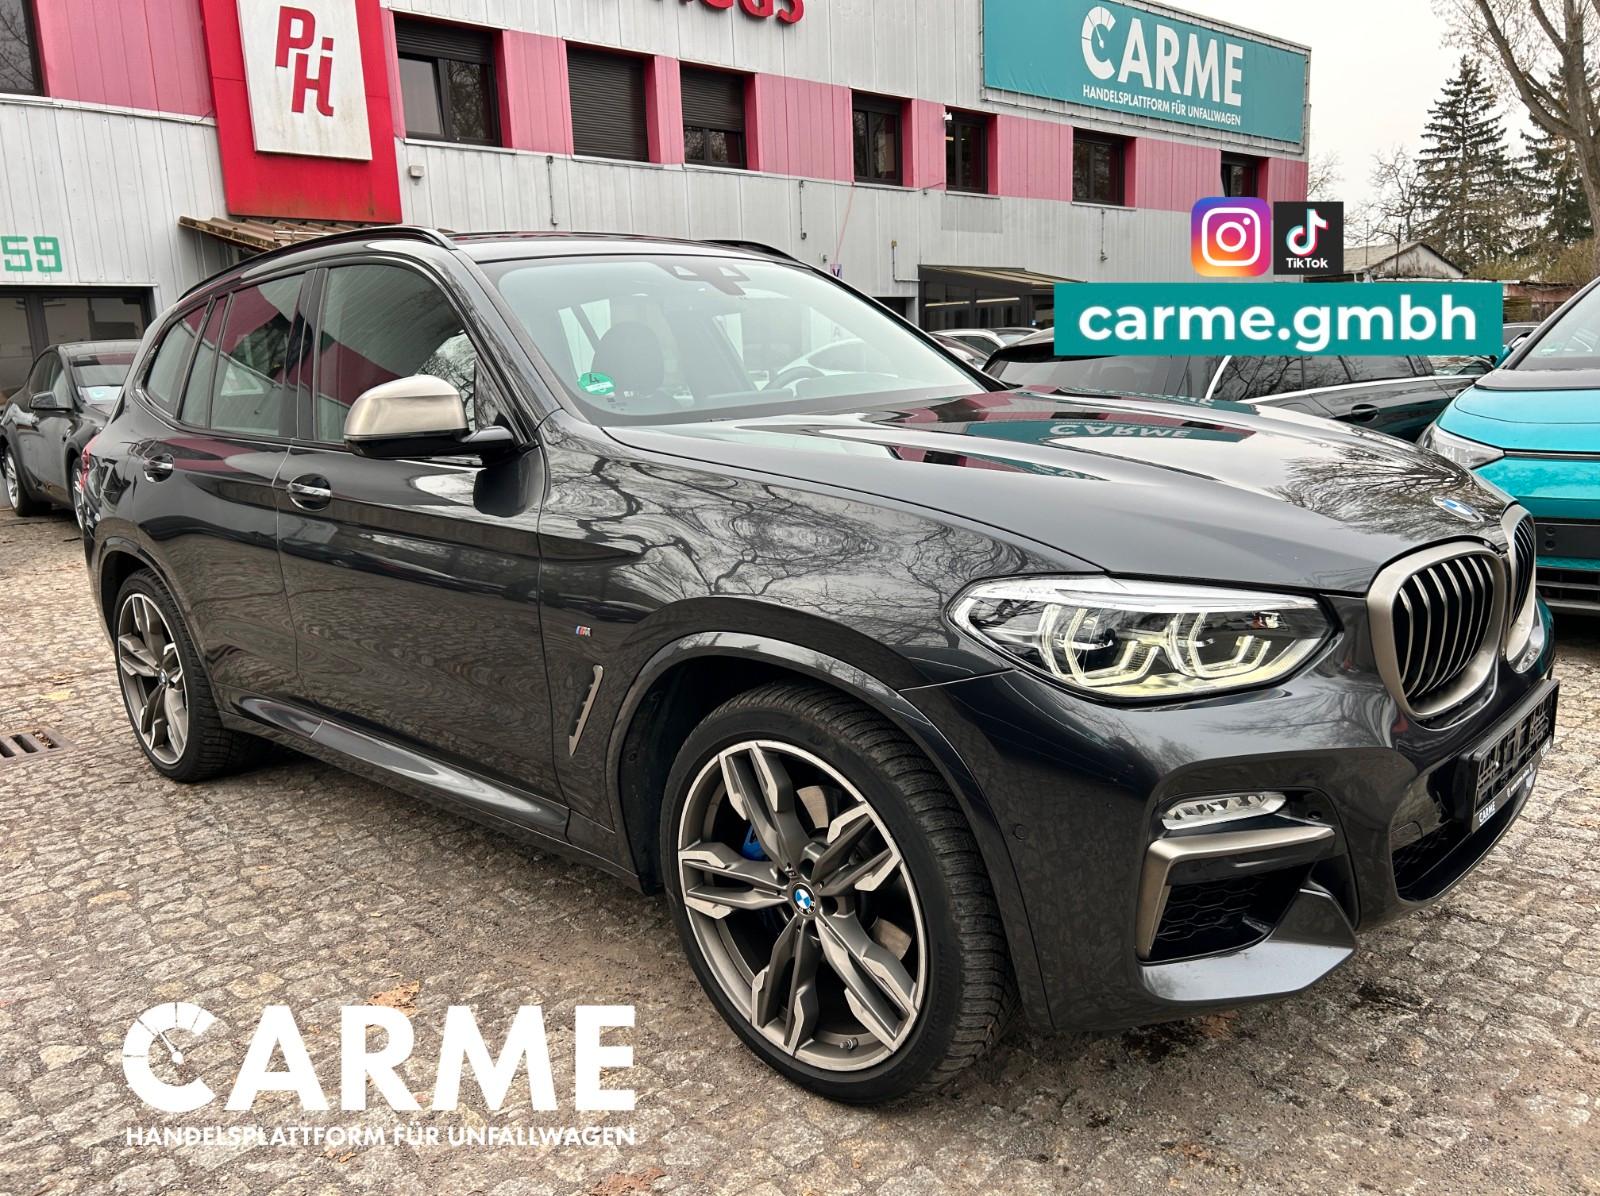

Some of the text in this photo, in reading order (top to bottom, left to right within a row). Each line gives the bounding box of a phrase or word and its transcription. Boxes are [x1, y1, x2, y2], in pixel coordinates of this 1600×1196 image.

[1081, 6, 1244, 107] CARME
[1083, 84, 1241, 126] HANDELSPLATTFORM FÜR UNFALLWAGEN
[0, 235, 63, 273] 59
